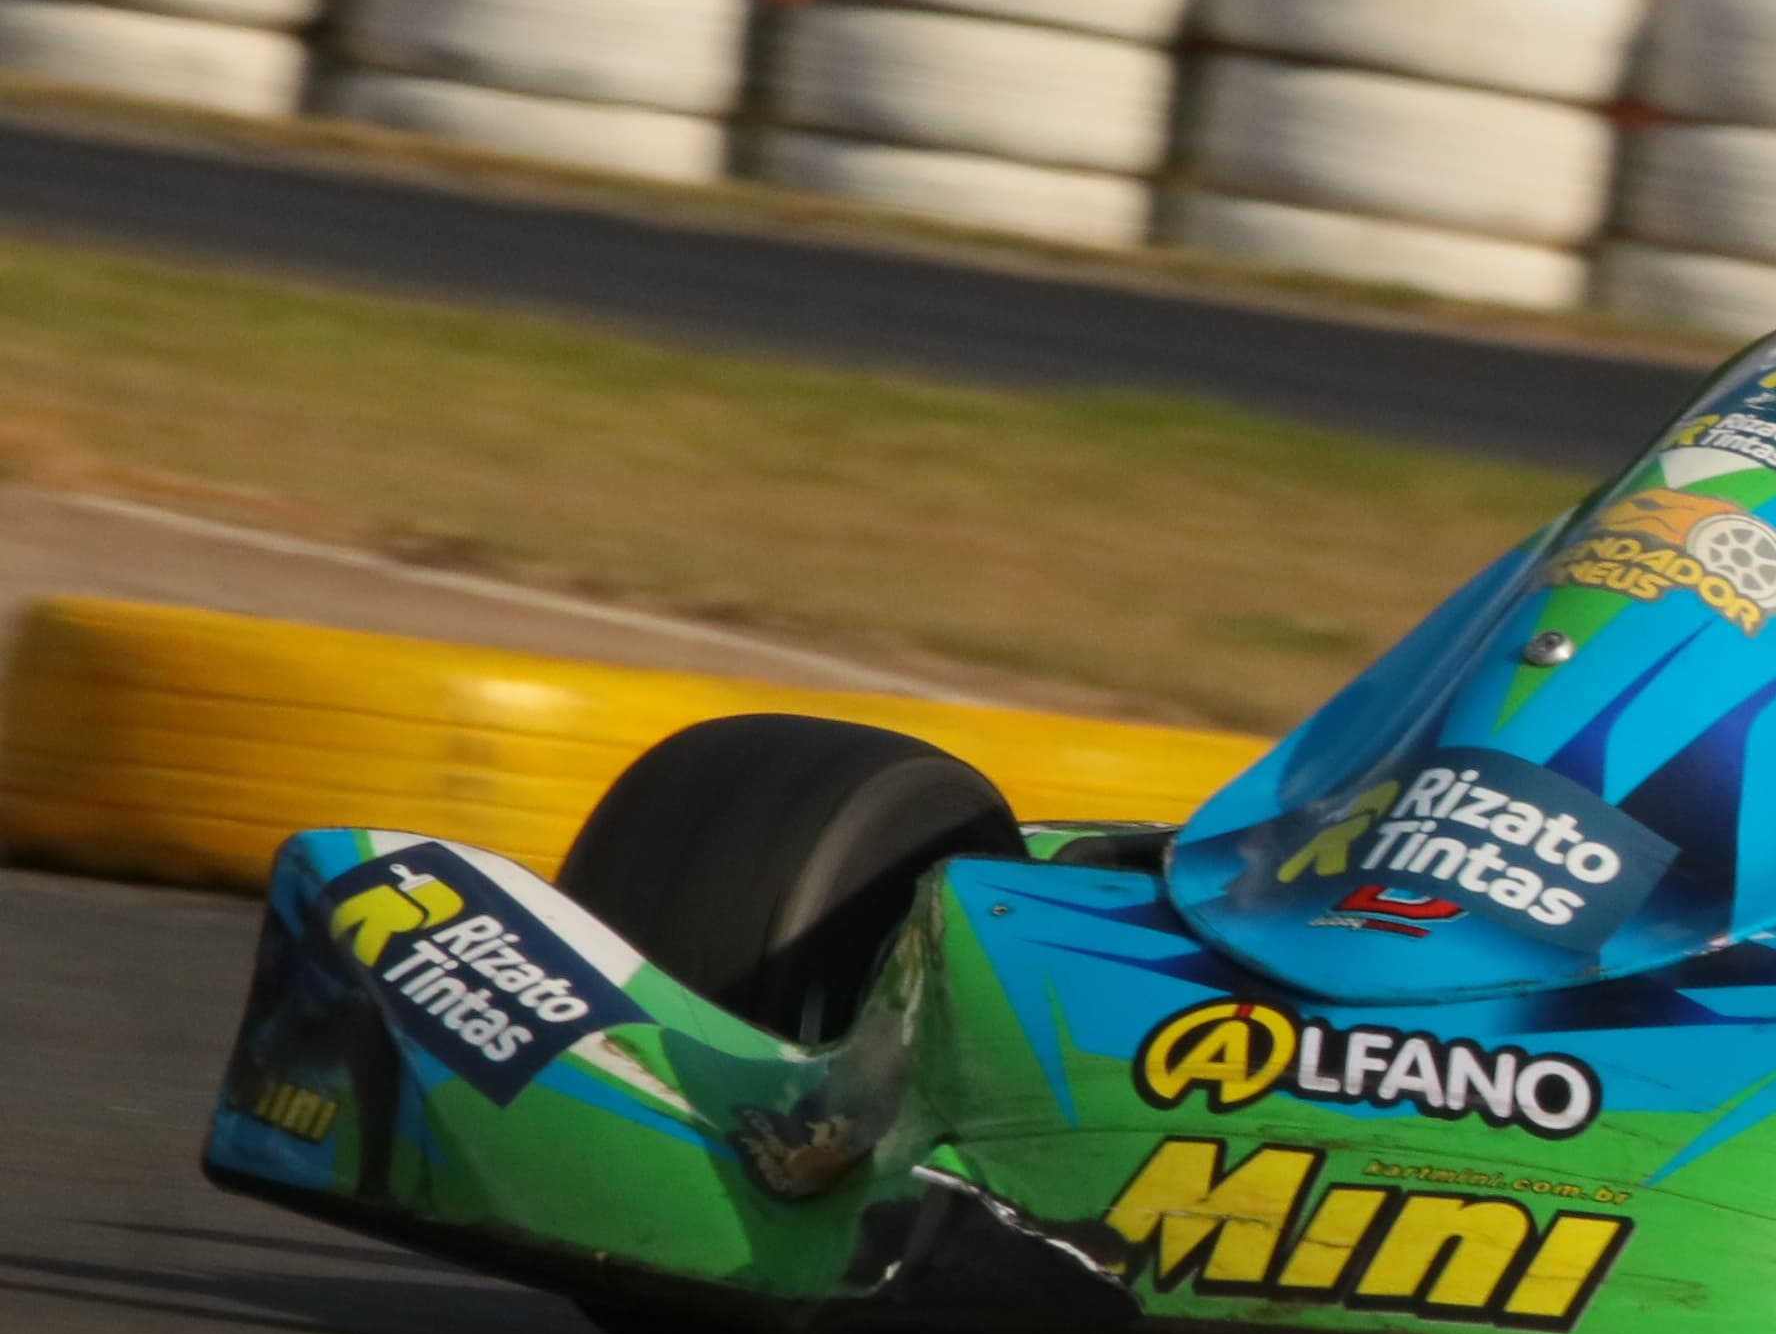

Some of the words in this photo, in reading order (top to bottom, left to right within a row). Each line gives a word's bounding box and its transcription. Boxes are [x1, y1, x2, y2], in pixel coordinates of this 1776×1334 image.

[1360, 817, 1588, 927] Tintas
[1392, 766, 1622, 887] Rizato
[382, 939, 535, 1064] Tintas
[432, 913, 591, 1025] Rizato
[1140, 999, 1597, 1135] ALFANO
[1104, 1137, 1633, 1334] Mini
